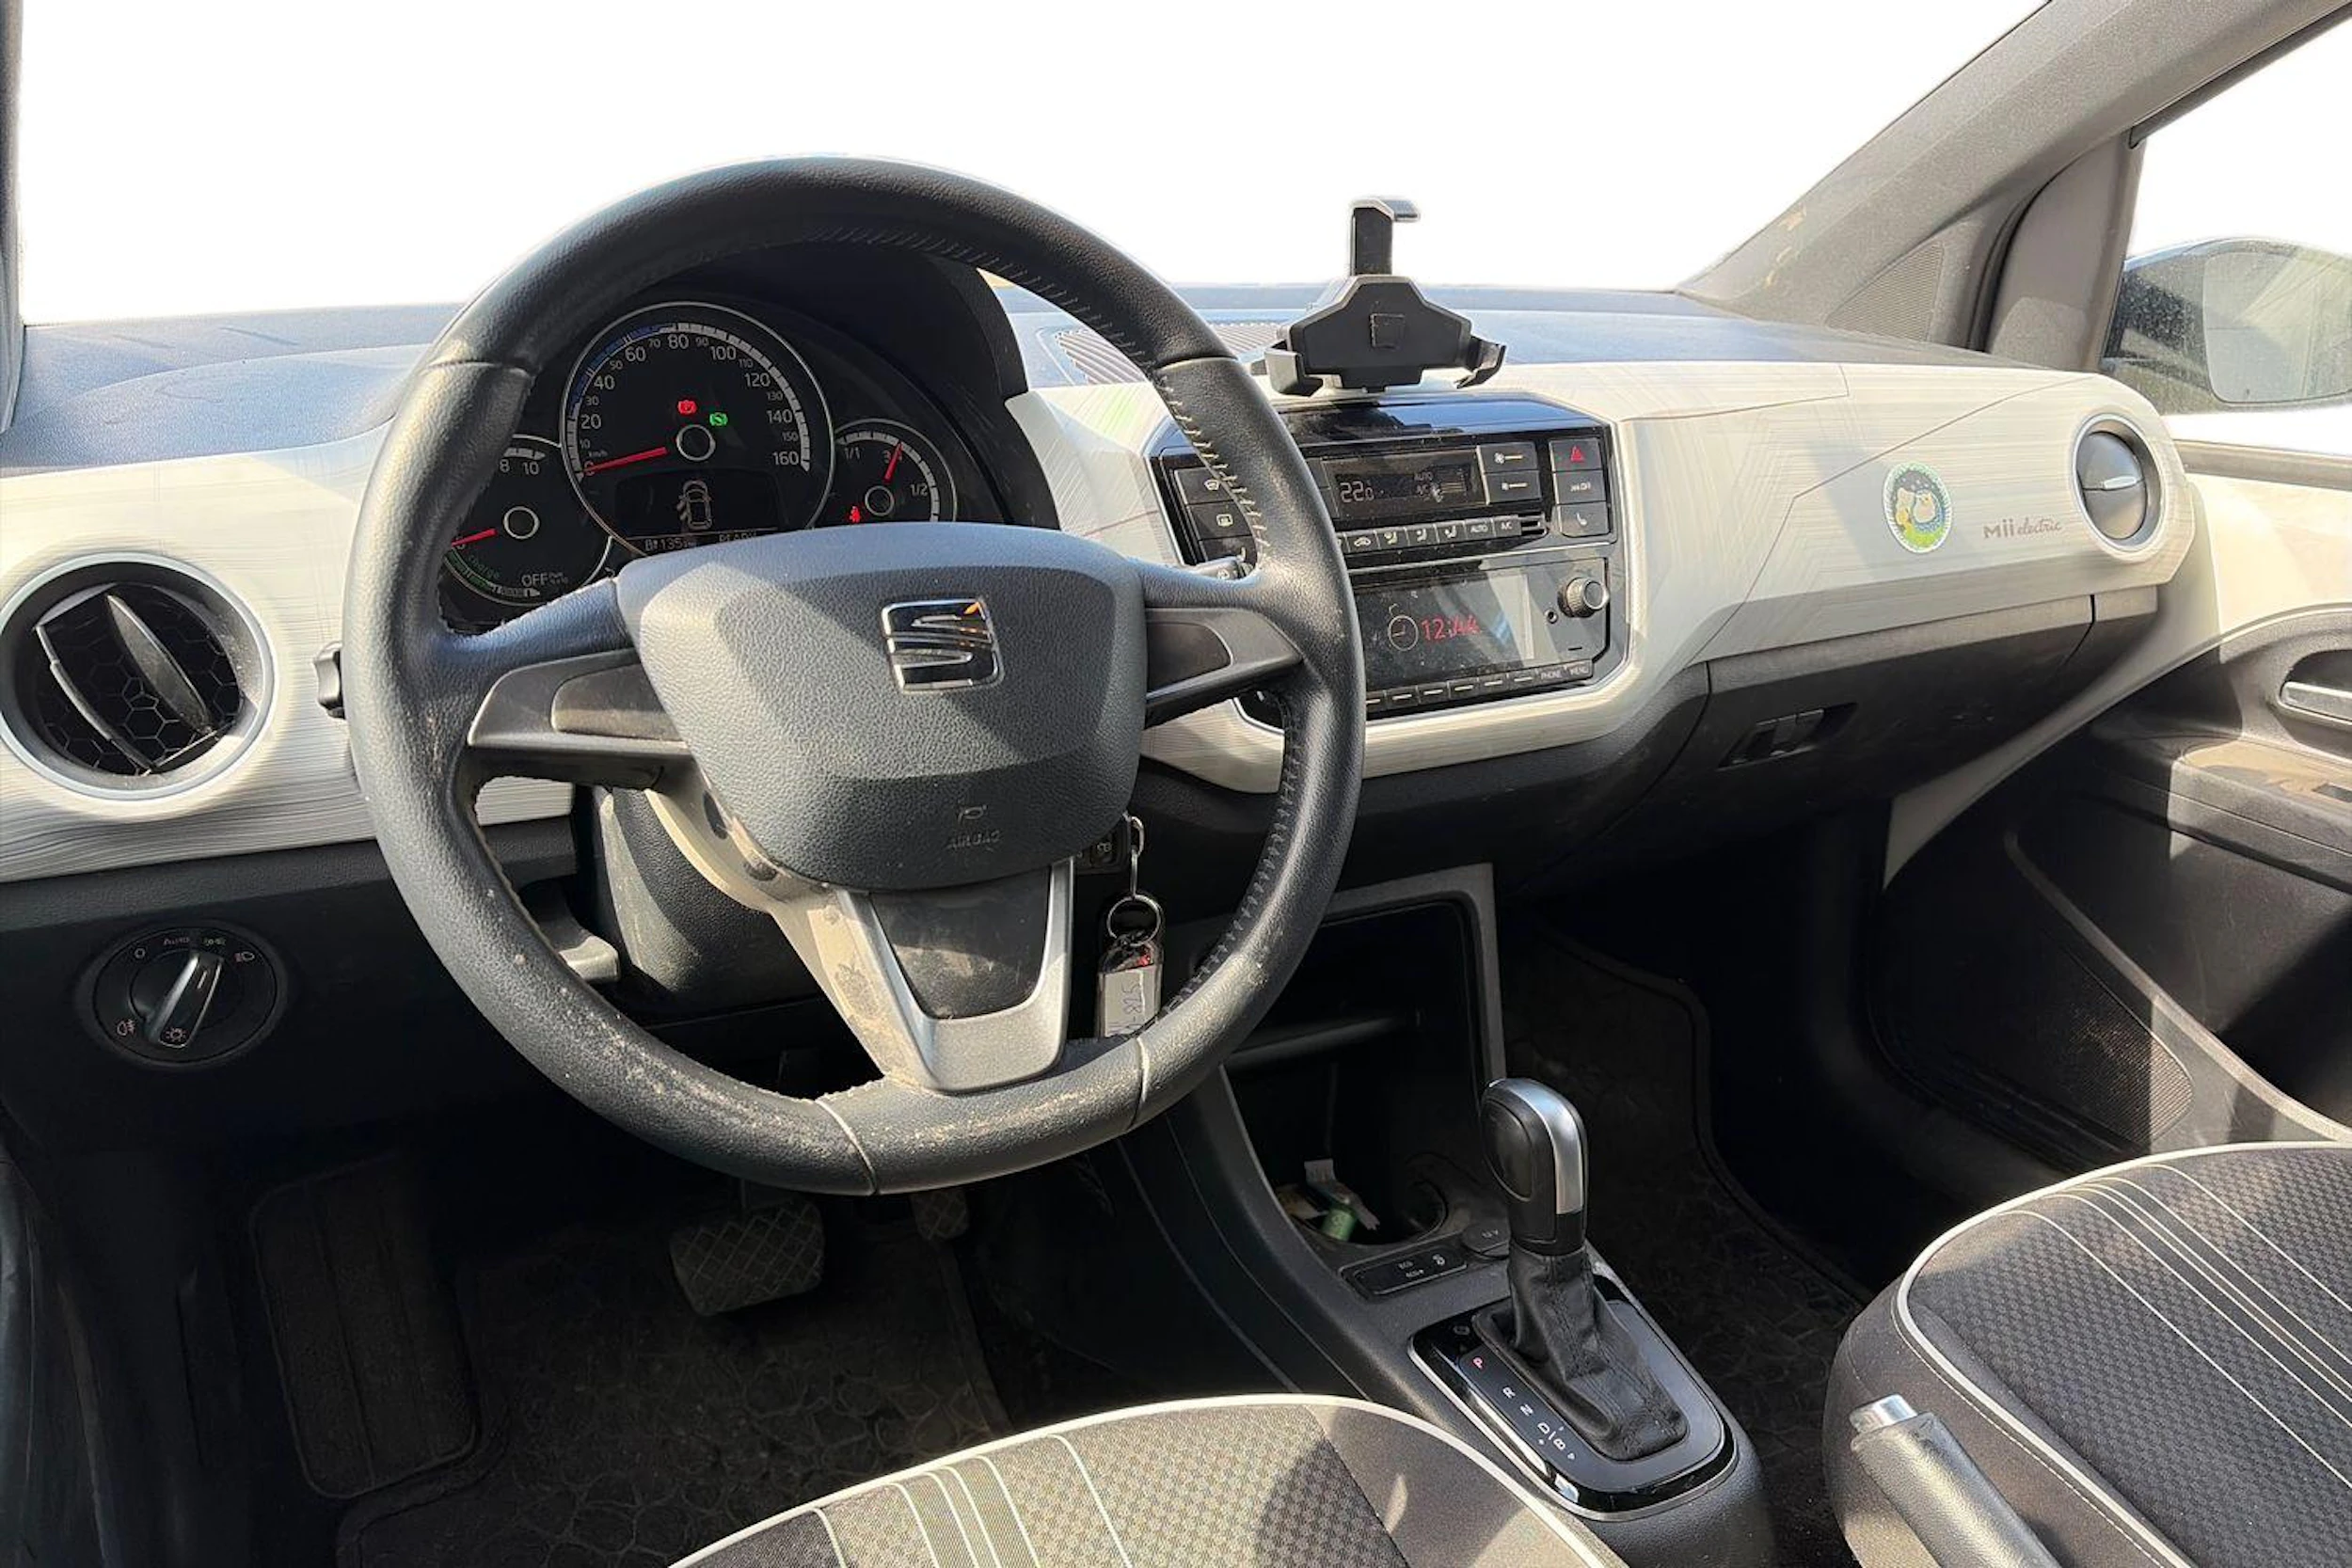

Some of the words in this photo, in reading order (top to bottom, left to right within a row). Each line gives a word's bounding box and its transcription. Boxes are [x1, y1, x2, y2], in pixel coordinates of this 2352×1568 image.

[648, 339, 660, 348] 70
[667, 334, 689, 349] 80
[695, 337, 708, 347] 90
[625, 346, 646, 361] 60
[709, 346, 737, 360] 100
[610, 359, 623, 370] 50
[739, 358, 754, 368] 110
[594, 375, 615, 389] 40
[744, 373, 771, 387] 120
[585, 395, 599, 405] 30
[766, 391, 783, 401] 130
[580, 414, 602, 429] 20
[767, 409, 792, 423] 140
[580, 439, 591, 449] 10
[782, 432, 799, 442] 150
[772, 451, 799, 465] 160
[500, 459, 510, 472] 8
[522, 461, 540, 475] 10
[911, 483, 930, 497] 1/2
[1983, 518, 2013, 538] Mii
[2017, 516, 2062, 535] electric
[521, 573, 548, 587] OFF
[1472, 1356, 1484, 1370] P
[1502, 1386, 1517, 1399] R
[1519, 1403, 1534, 1417] N
